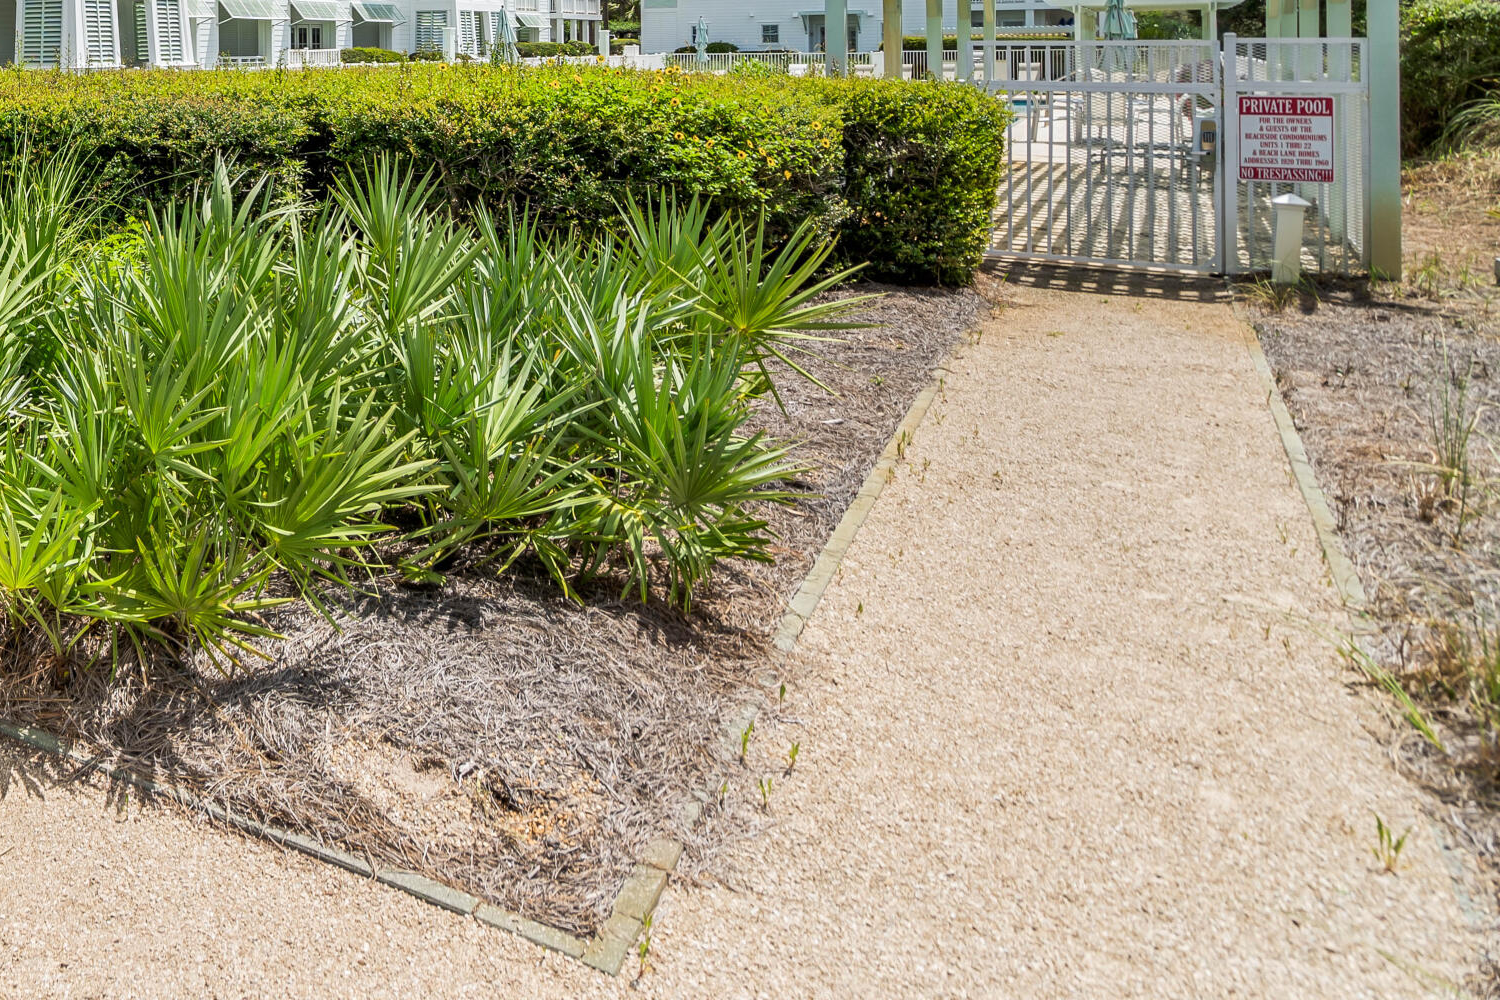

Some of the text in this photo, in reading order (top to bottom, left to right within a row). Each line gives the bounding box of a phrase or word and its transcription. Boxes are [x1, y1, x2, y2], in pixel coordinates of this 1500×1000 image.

[1242, 99, 1329, 114] PRIVATE POOL
[1286, 117, 1312, 125] OWNERS
[1241, 167, 1332, 181] NO TRESPASSING!!!
